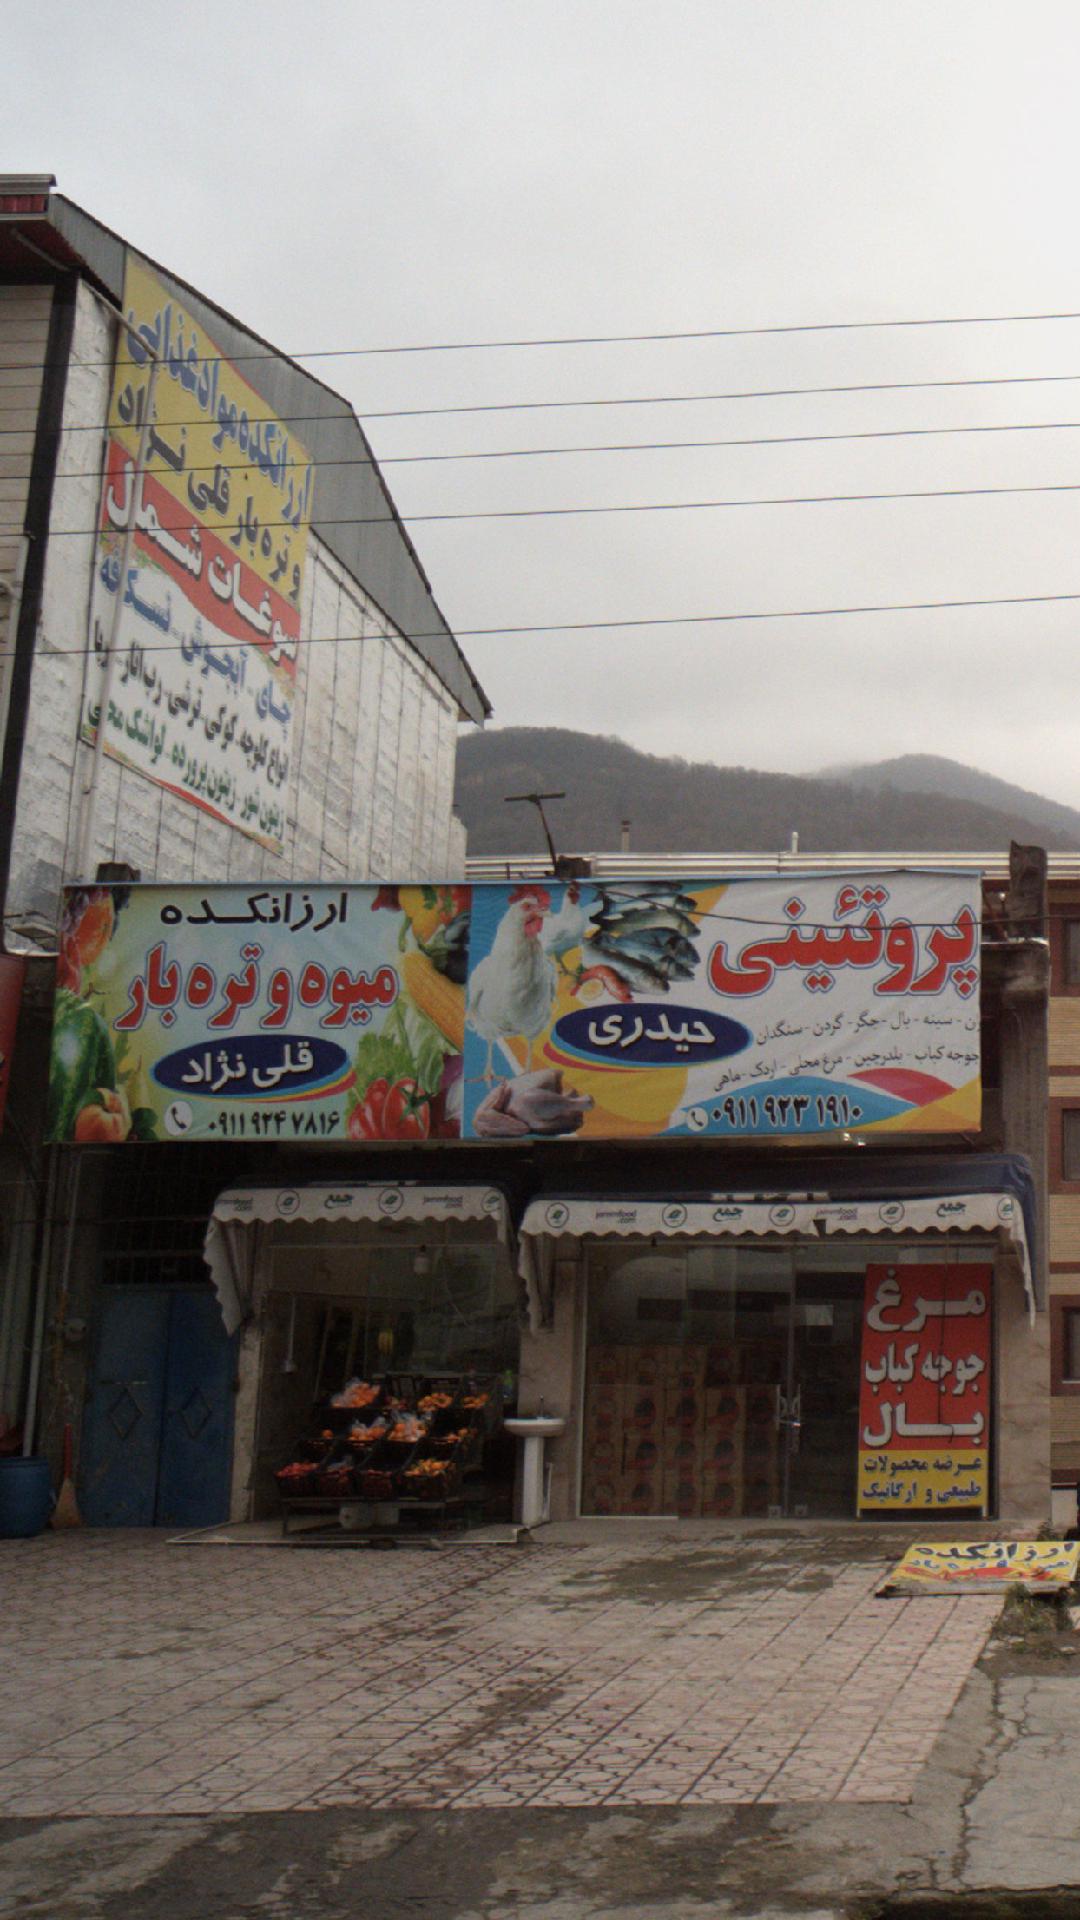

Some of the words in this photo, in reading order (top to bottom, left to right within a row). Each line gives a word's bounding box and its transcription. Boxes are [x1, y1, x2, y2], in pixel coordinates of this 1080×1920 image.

[198, 359, 236, 451] مواد
[188, 463, 230, 517] قلی
[239, 411, 311, 529] ارزانکده
[230, 496, 259, 557] بار
[260, 528, 289, 582] تره
[289, 563, 301, 601] و
[208, 555, 298, 666] سوغات
[255, 681, 291, 739] چای
[160, 892, 348, 933] ارزانکده
[707, 885, 977, 998] پروتئینی
[114, 942, 180, 1029] بار
[186, 943, 262, 1029] تره
[260, 967, 293, 1029] و
[295, 961, 399, 1029] میوه
[588, 1011, 717, 1054] حیدری
[756, 1020, 803, 1045] سنگدان
[914, 1046, 944, 1062] کباب
[181, 1053, 246, 1092] نژاد
[251, 1042, 314, 1085] قلی
[947, 1049, 978, 1065] جوجه
[208, 1113, 245, 1136] ۰۹۱۱
[250, 1111, 287, 1135] ۹۲۴
[292, 1110, 340, 1134] ۷۸۱۶
[712, 1095, 759, 1128] ۰۹۱۱
[764, 1096, 809, 1127] ۹۲۳
[816, 1095, 863, 1126] ۱۹۱۰
[866, 1268, 986, 1332] مرغ
[864, 1342, 919, 1395] کباب
[921, 1351, 986, 1395] جوجه
[862, 1401, 985, 1448] بال
[864, 1455, 929, 1479] محصولات
[933, 1456, 982, 1480] عرضه
[862, 1481, 918, 1504] ارگانیک
[924, 1489, 932, 1504] و
[936, 1480, 982, 1505] طبیعی
